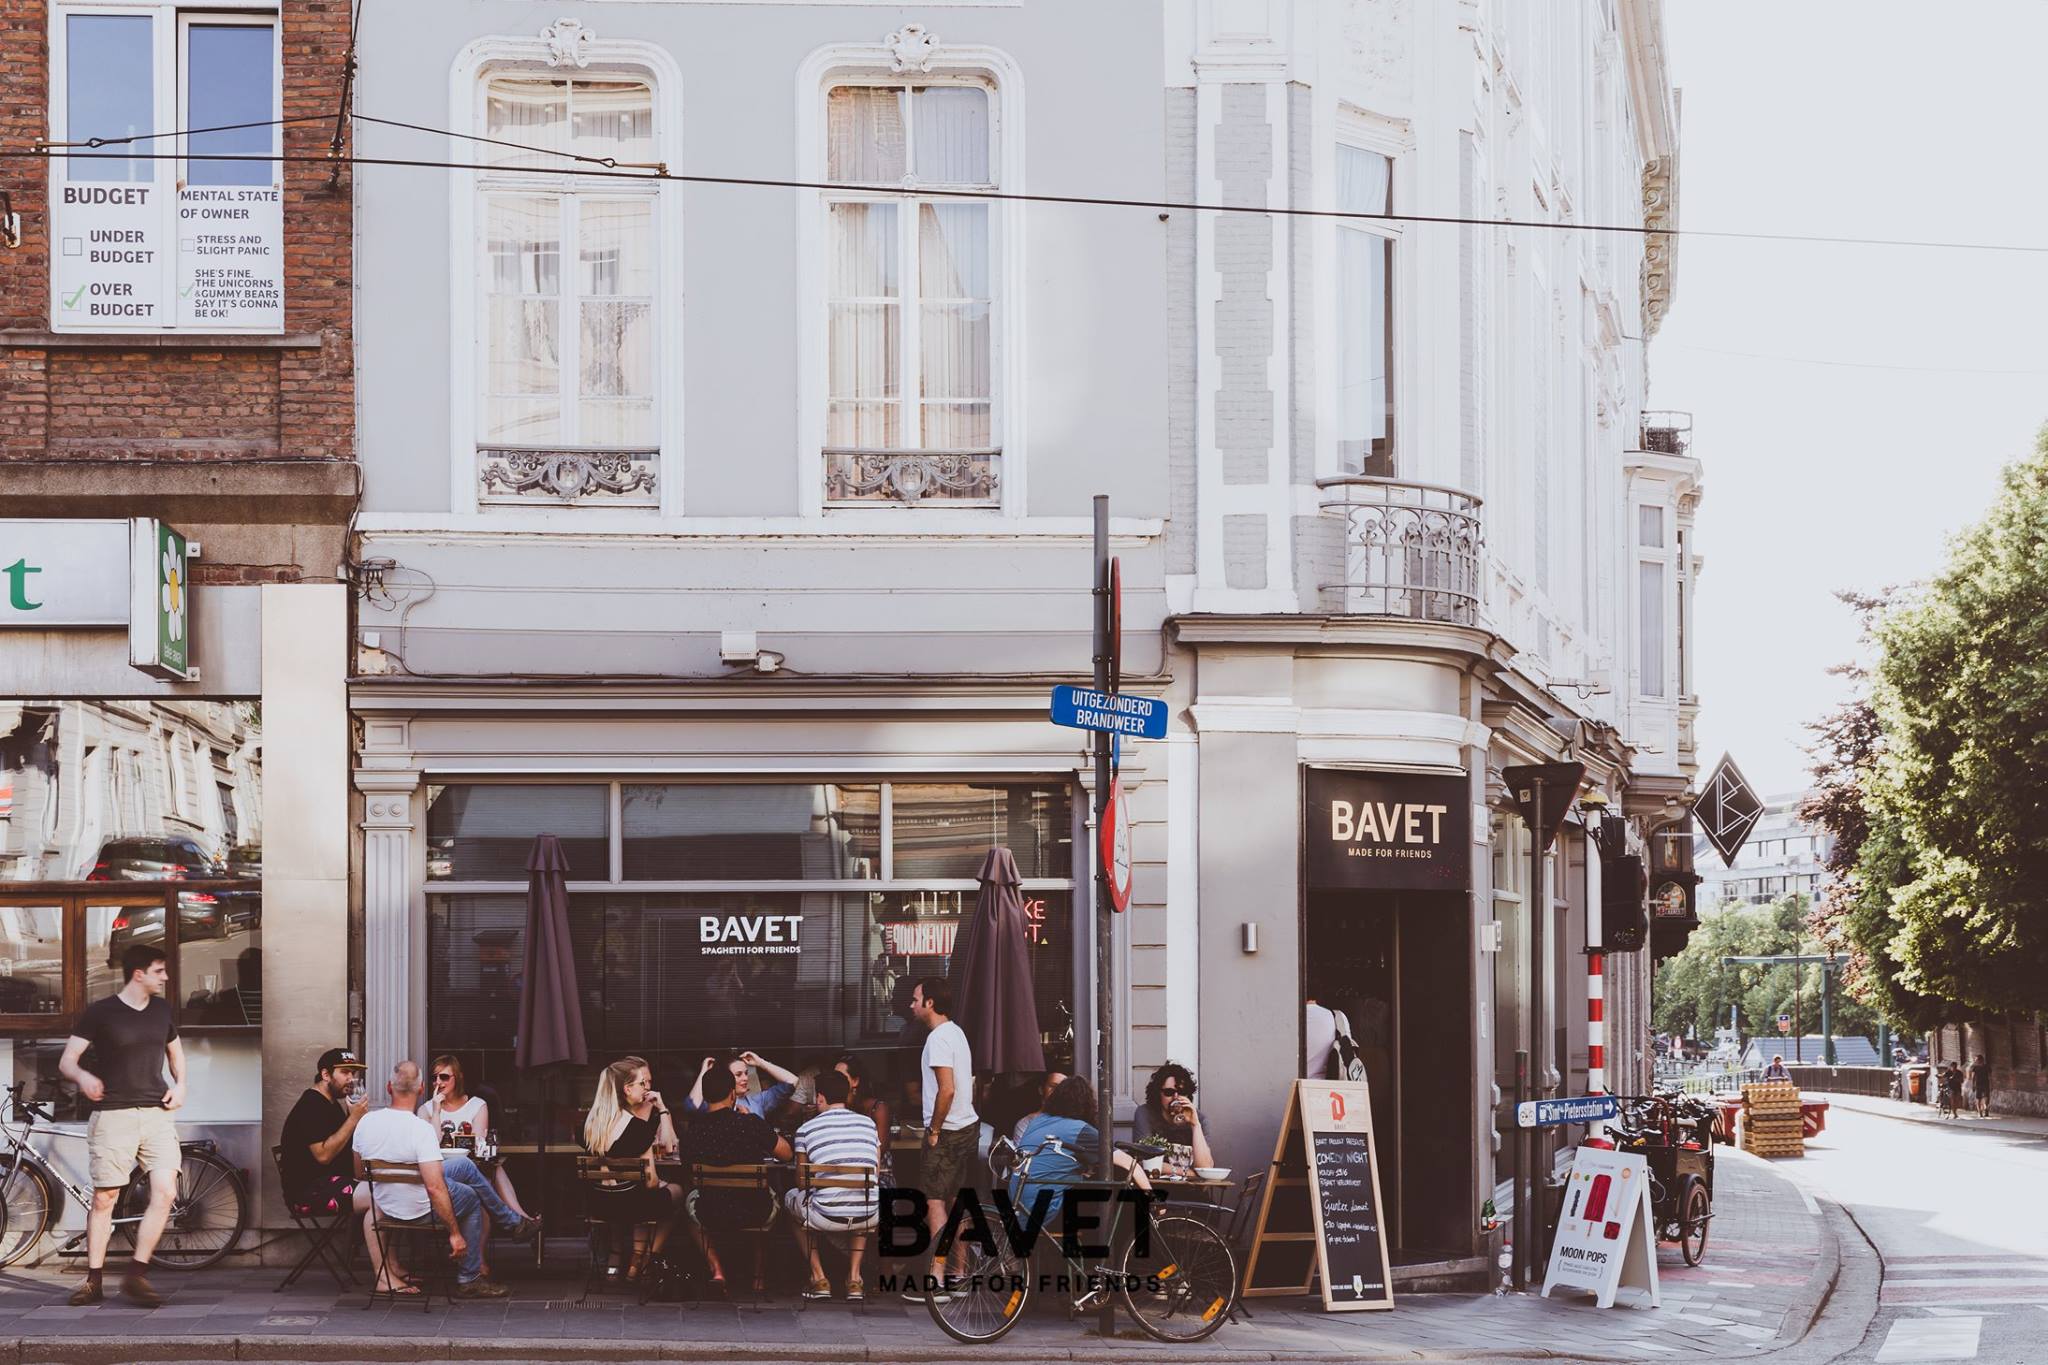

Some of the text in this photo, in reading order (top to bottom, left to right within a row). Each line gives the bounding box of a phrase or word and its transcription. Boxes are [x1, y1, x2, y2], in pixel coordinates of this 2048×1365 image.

[63, 187, 150, 205] BUDGET
[180, 190, 279, 202] MENTAL STATE
[180, 208, 250, 219] OF OWNER
[90, 230, 145, 243] UNDER
[196, 235, 262, 244] STRESS AND
[90, 250, 155, 263] BUDGET
[196, 246, 270, 255] SLIGHT PANIC
[195, 269, 225, 278] SHE'S
[90, 283, 133, 296] OVER
[195, 279, 274, 288] THE UNICORNS
[244, 290, 279, 299] BEARS
[90, 303, 155, 316] BUDGET
[195, 299, 216, 308] SAY
[239, 299, 278, 308] GONNA
[195, 309, 229, 318] BE OK!
[1072, 690, 1153, 717] UITGEZONDERD
[1076, 709, 1145, 734] BRANDWEER
[1331, 799, 1448, 845] BAVET
[1348, 847, 1432, 859] MADE FOR FRIENDS
[700, 915, 804, 942] BAVET
[701, 945, 801, 955] SPAGHETTI FOR FRIENDS
[1346, 1151, 1368, 1163] NIGHT
[1560, 1246, 1608, 1264] MOON POPS
